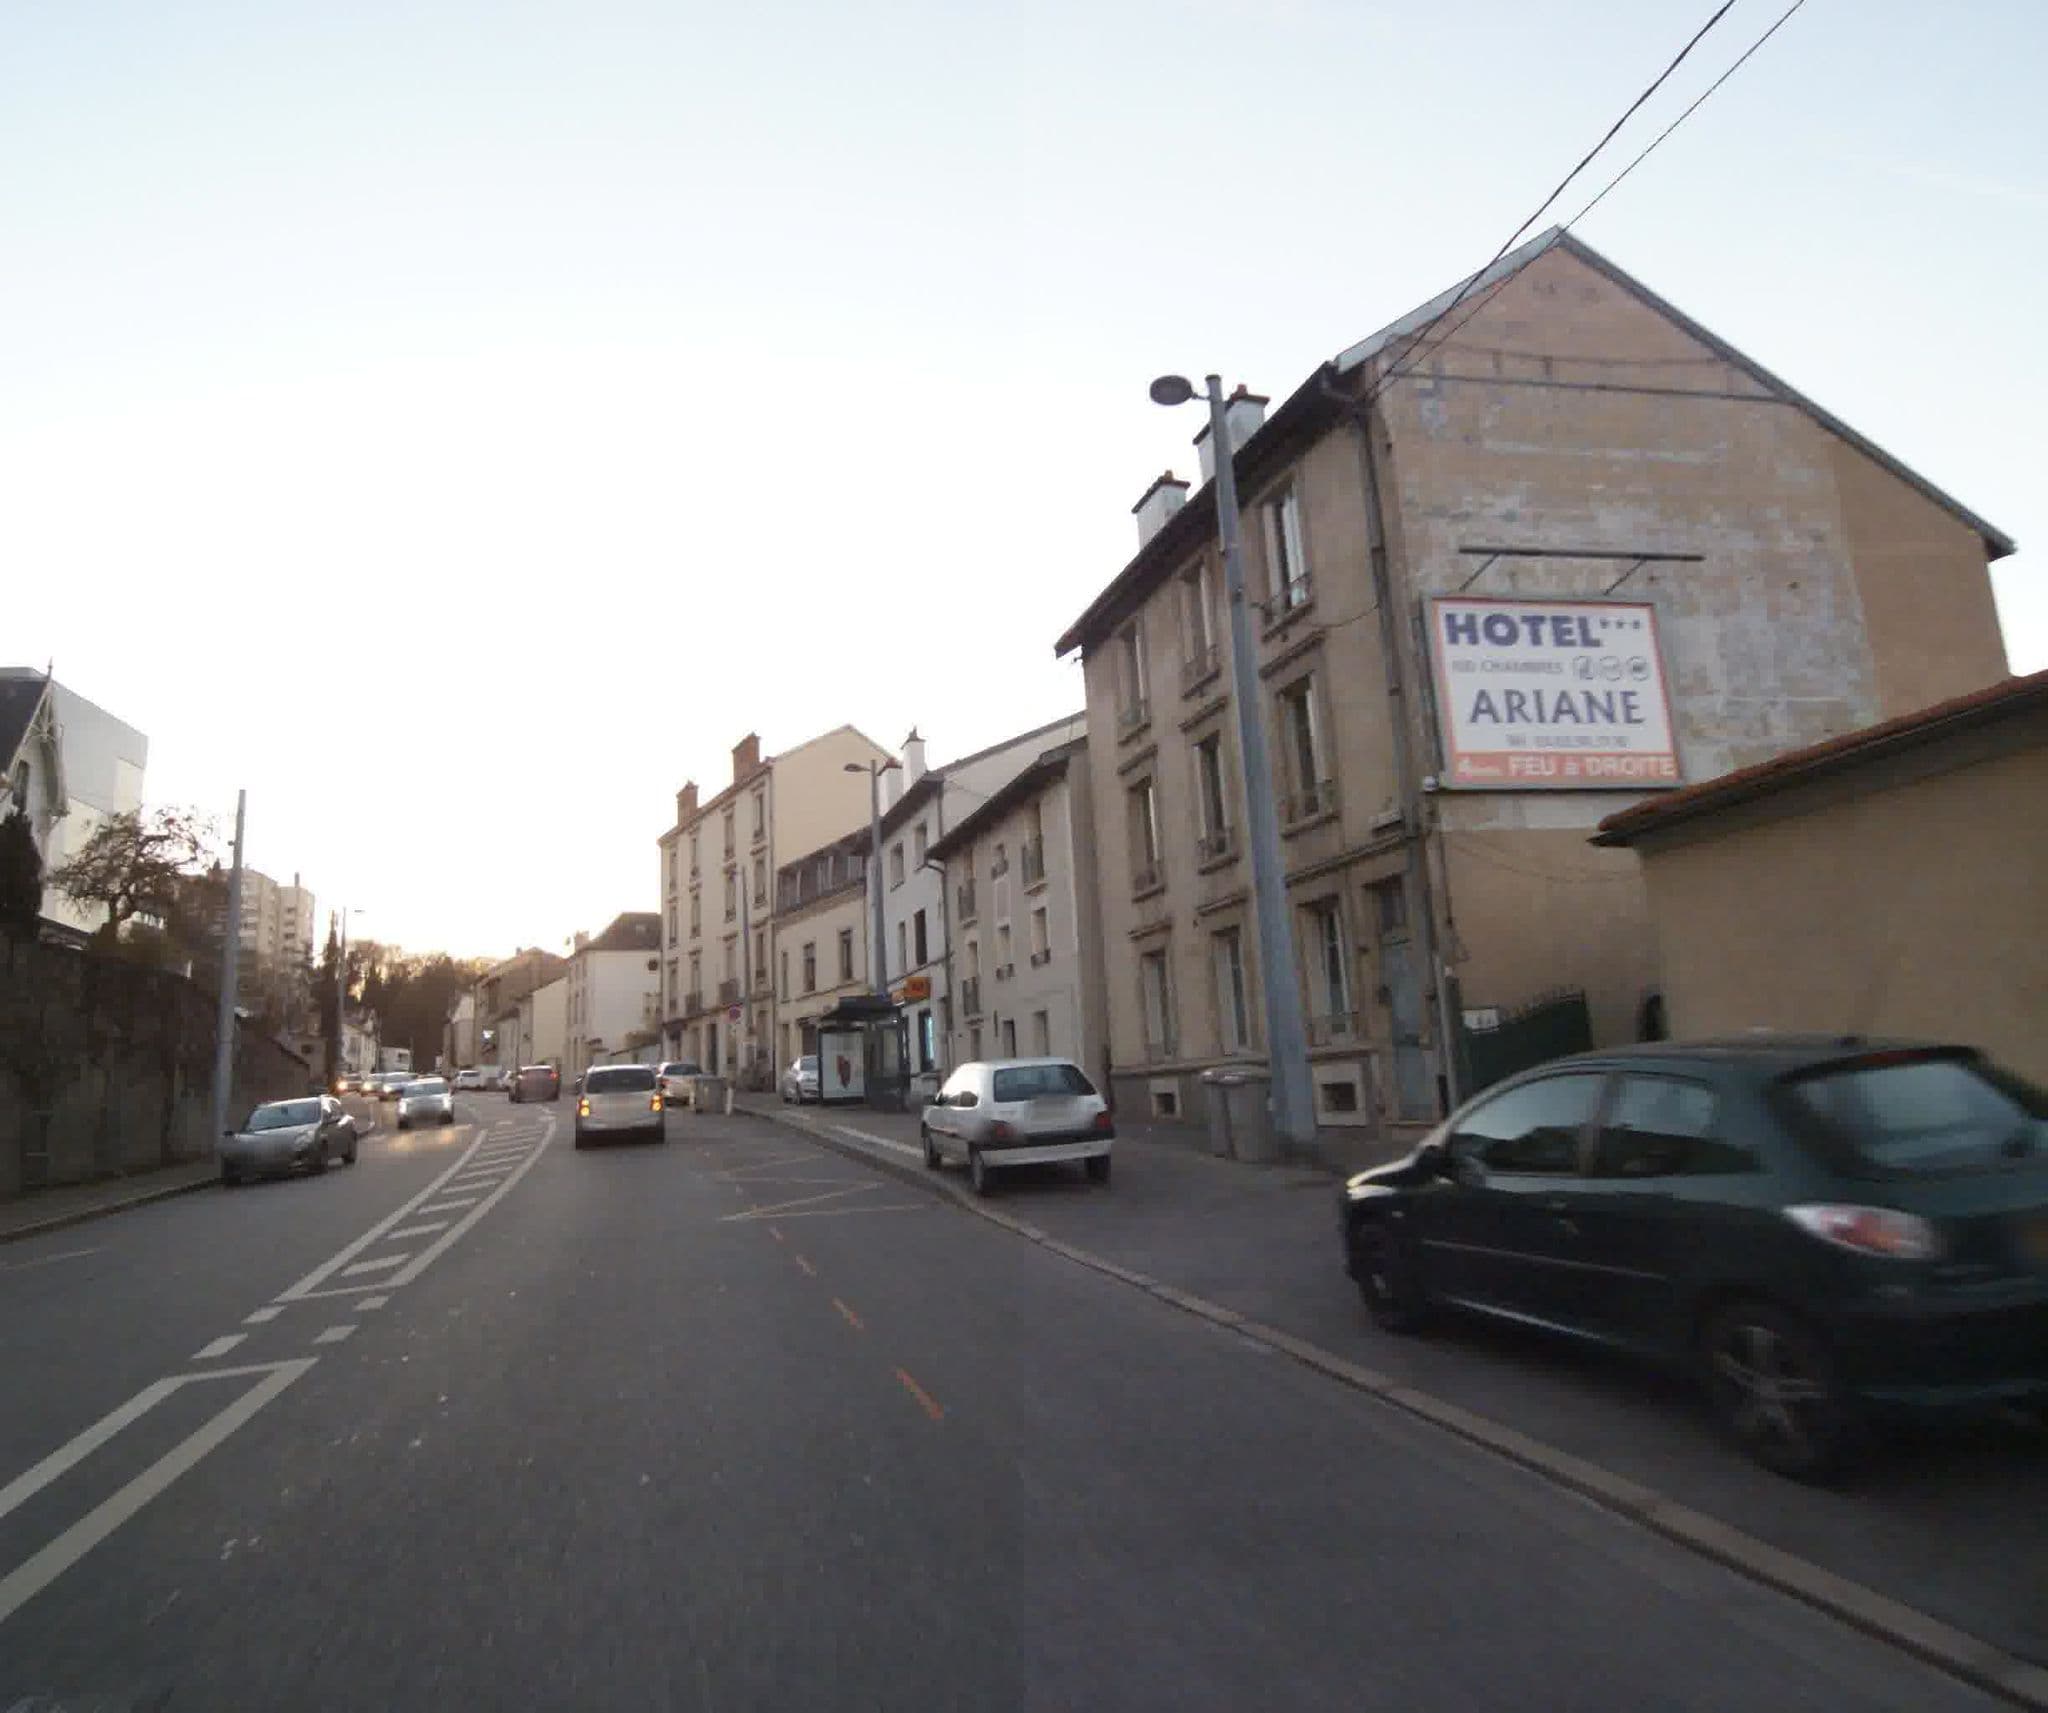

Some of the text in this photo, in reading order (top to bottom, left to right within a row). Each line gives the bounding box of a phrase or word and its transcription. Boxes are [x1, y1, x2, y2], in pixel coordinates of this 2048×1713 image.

[1445, 613, 1602, 647] HOTEL
[1469, 689, 1646, 724] ARIANE
[1509, 757, 1555, 776] FEU
[1587, 757, 1674, 777] DROITE
